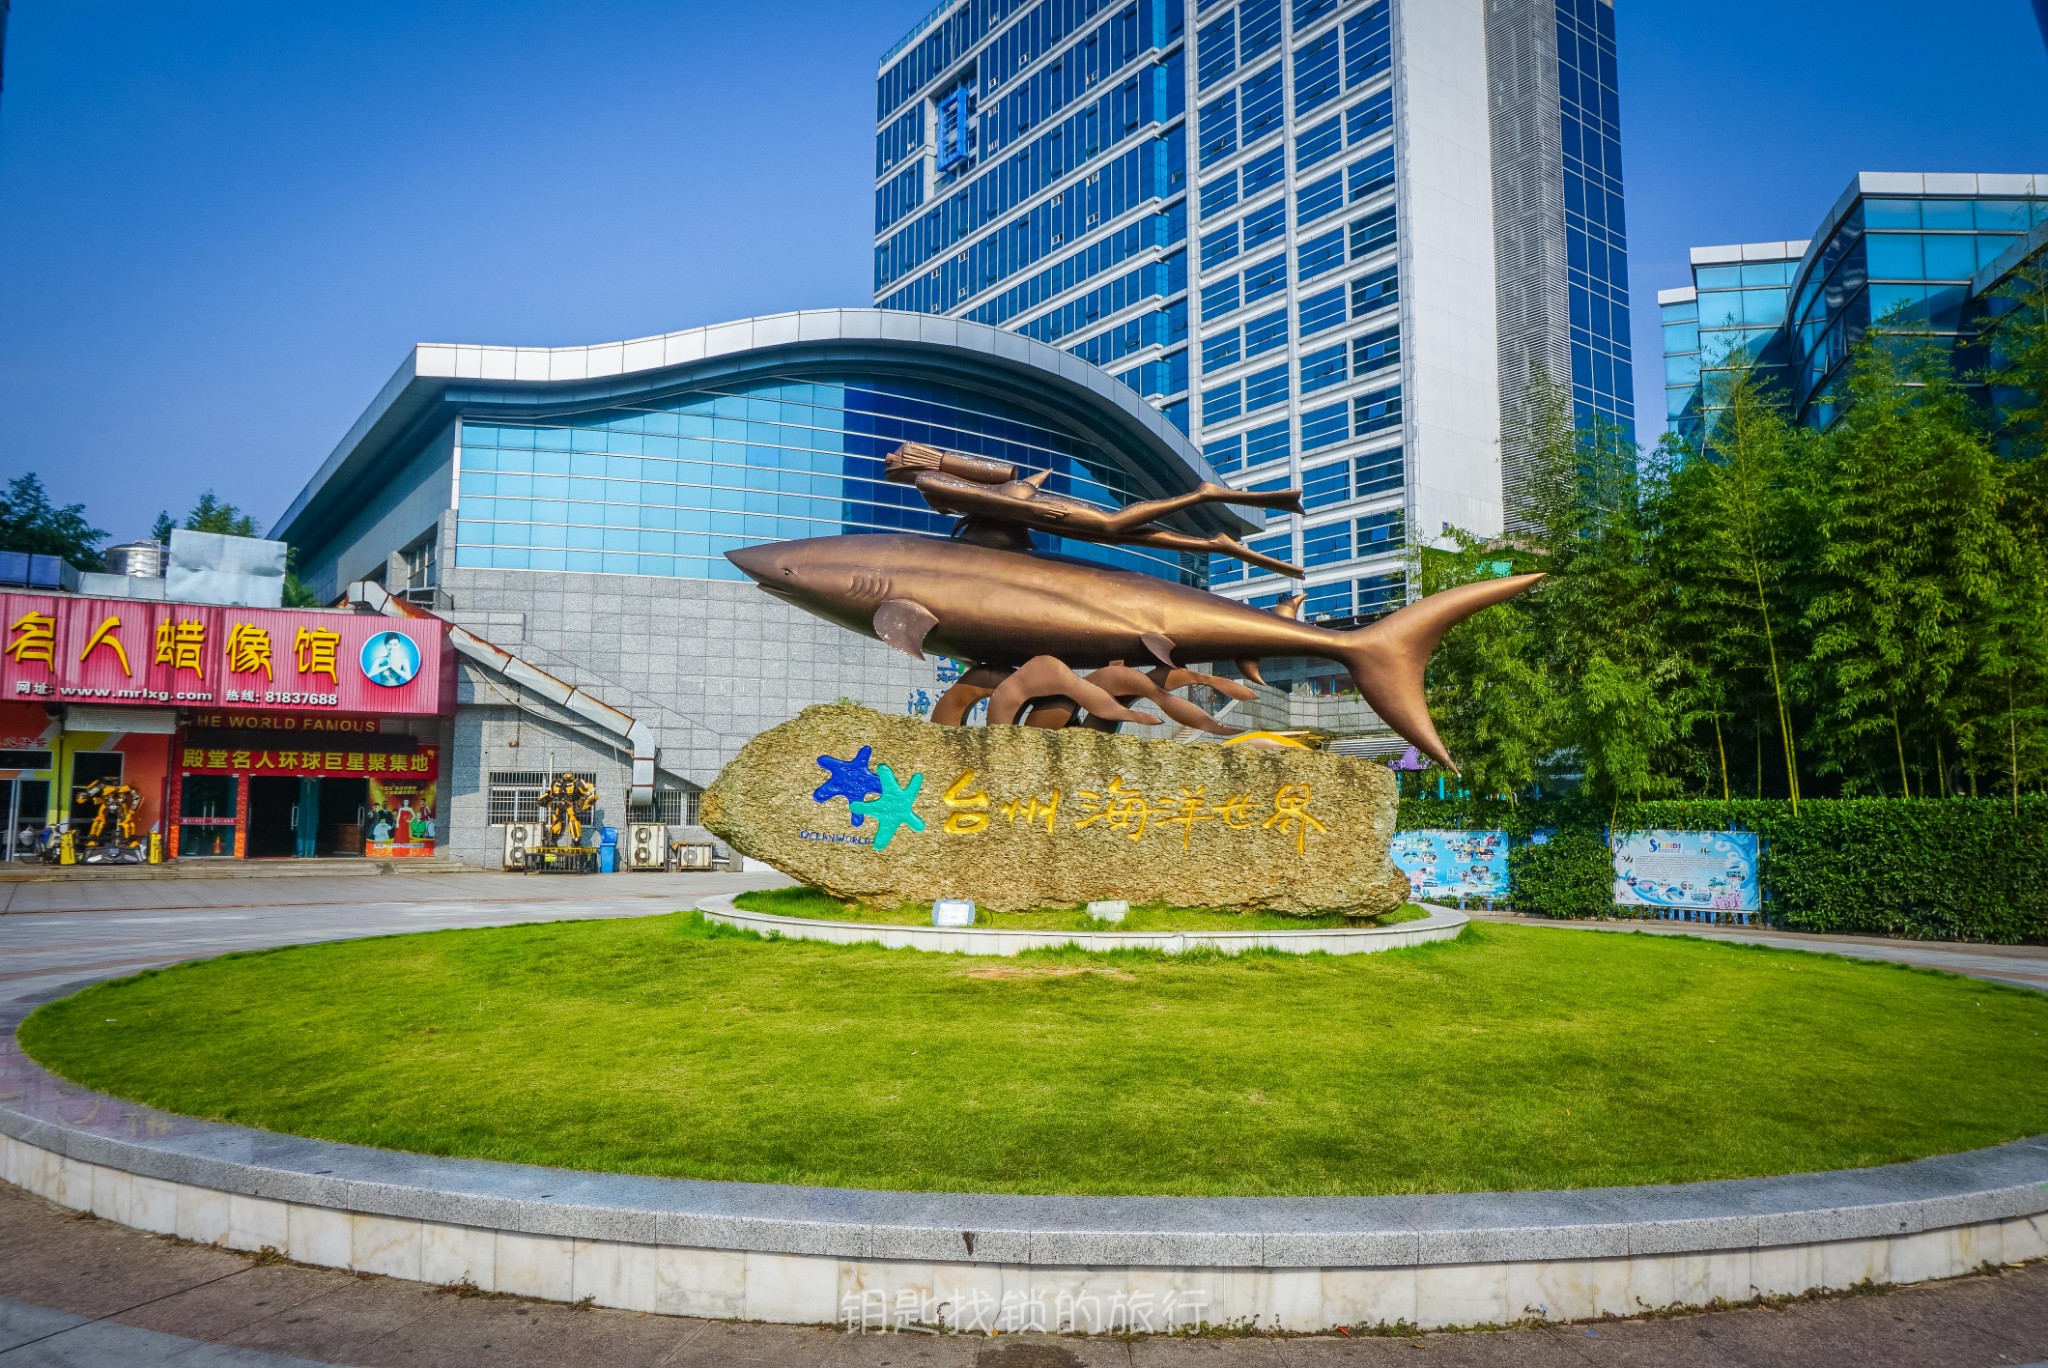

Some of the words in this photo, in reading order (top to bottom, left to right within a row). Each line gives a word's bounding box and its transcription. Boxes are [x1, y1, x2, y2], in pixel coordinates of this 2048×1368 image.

[5, 611, 341, 685] 名人蜡像馆
[60, 687, 213, 702] www.mrlxg.com
[265, 691, 338, 706] 81837688
[190, 714, 222, 728] HE
[229, 716, 296, 730] WORLD
[303, 718, 376, 733] FAMOUS
[943, 768, 1328, 855] 台州海洋世界
